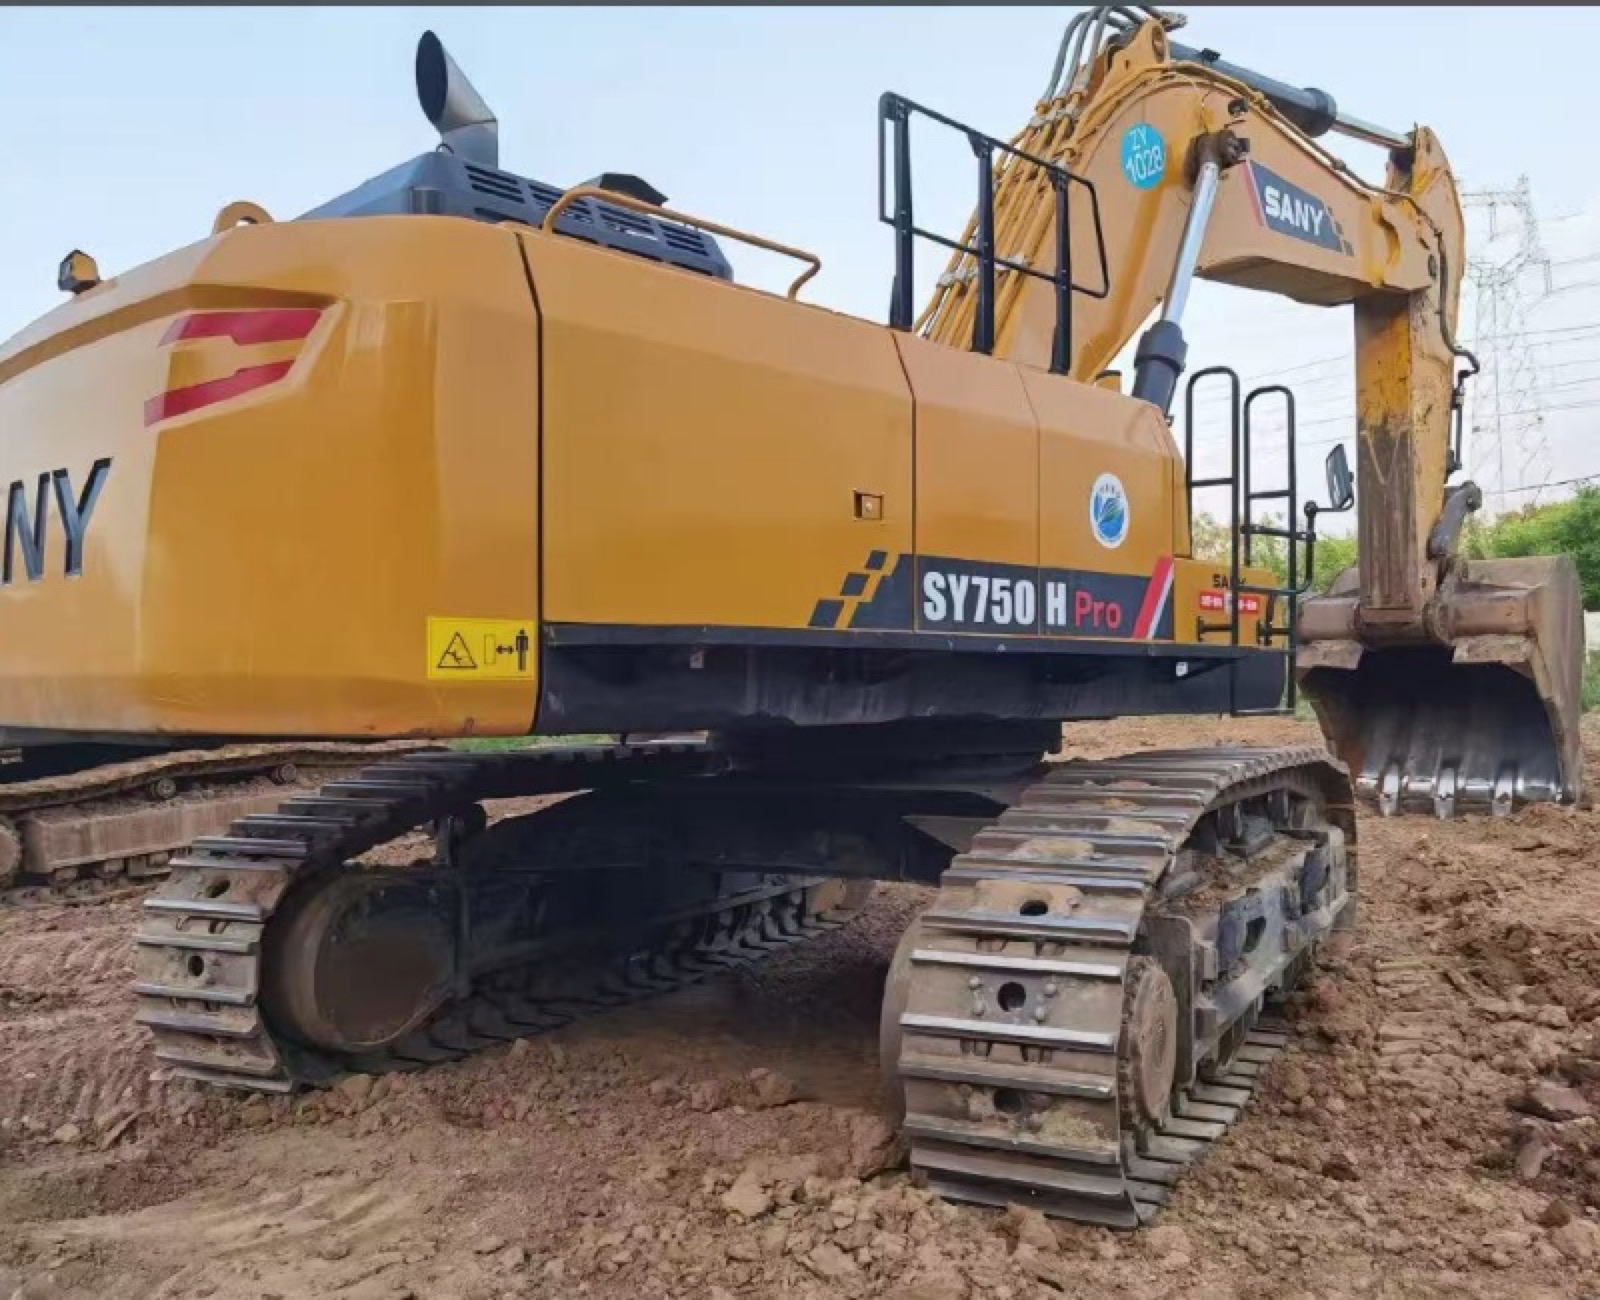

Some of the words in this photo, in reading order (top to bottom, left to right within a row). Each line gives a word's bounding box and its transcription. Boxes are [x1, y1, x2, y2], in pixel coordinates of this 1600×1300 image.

[1125, 146, 1163, 183] 1028
[1263, 186, 1324, 236] SANY
[923, 571, 1036, 625] SY750
[1046, 581, 1067, 626] H
[1075, 590, 1121, 629] Pro
